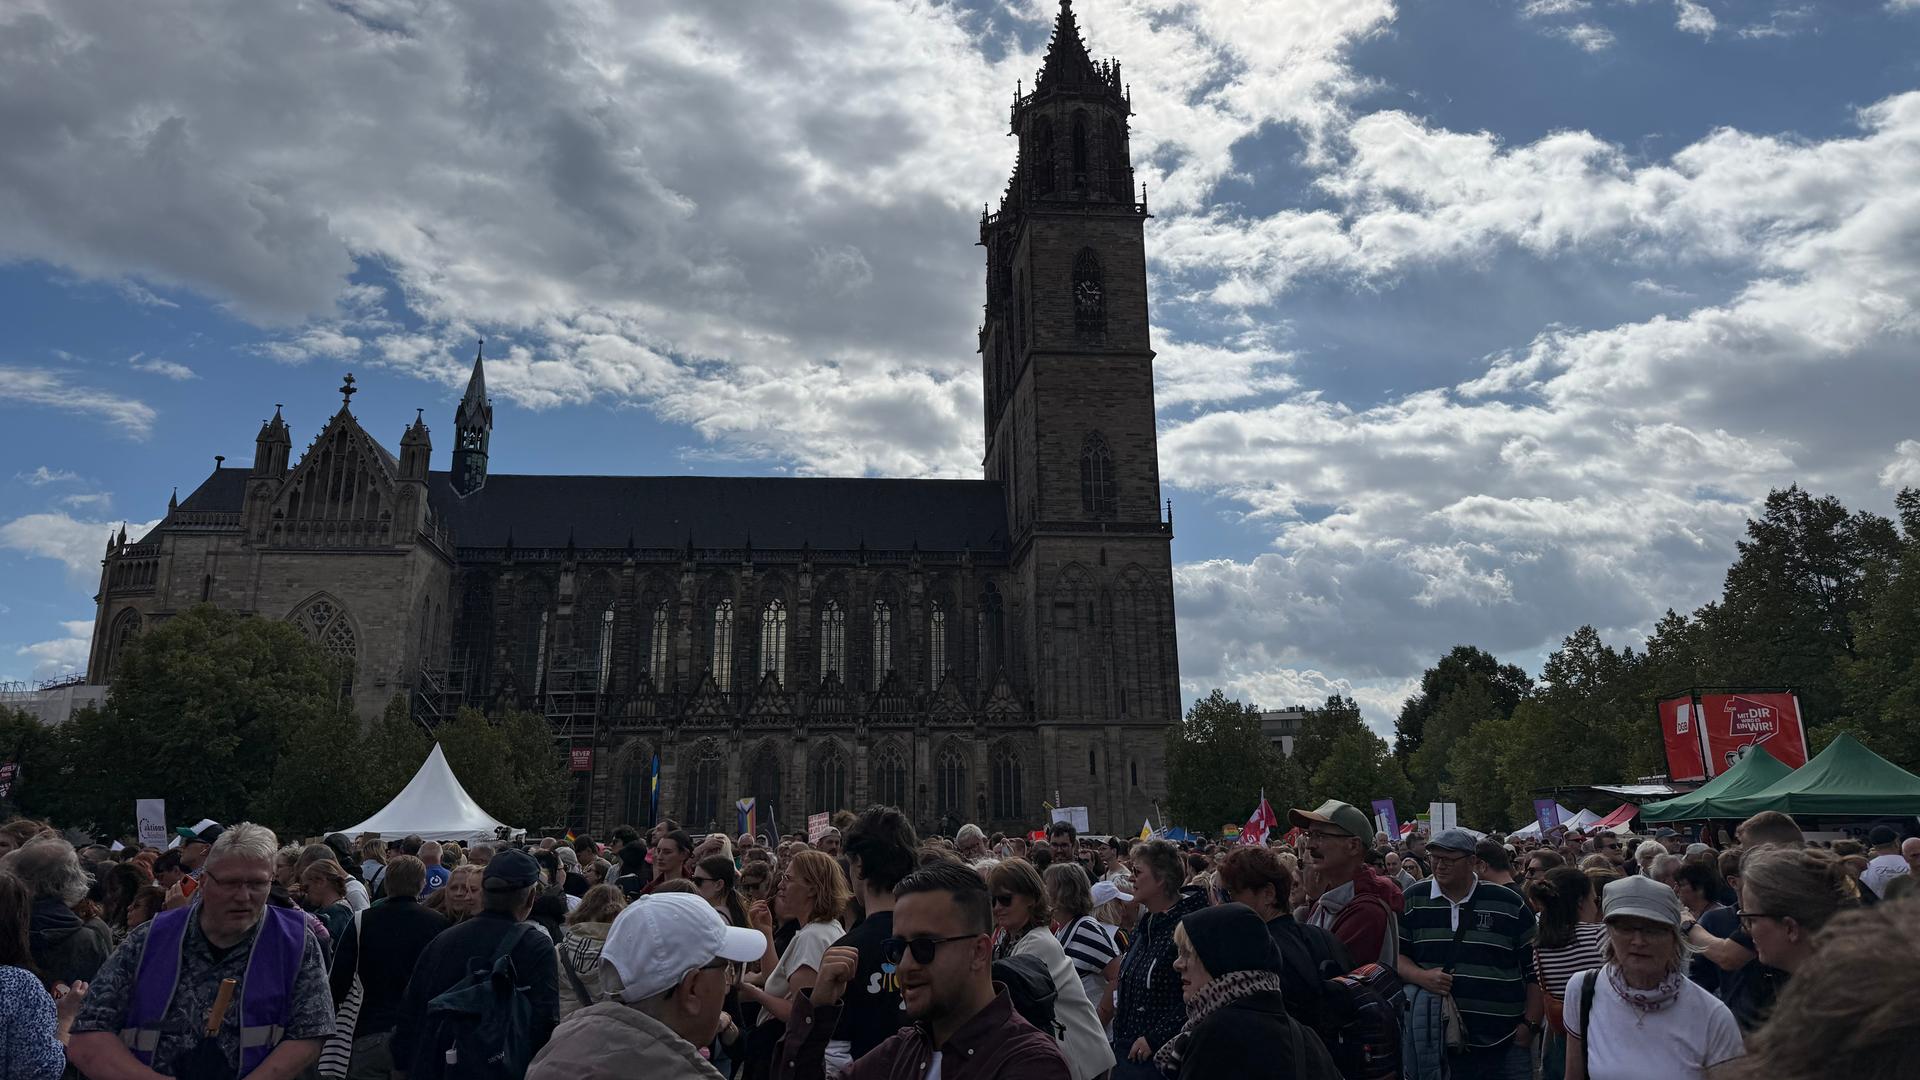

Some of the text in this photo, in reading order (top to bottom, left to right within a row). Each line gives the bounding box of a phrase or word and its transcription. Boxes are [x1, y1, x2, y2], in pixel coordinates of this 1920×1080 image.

[1749, 708, 1770, 718] DIR
[1678, 721, 1687, 732] DGB
[1748, 722, 1773, 732] WIR!
